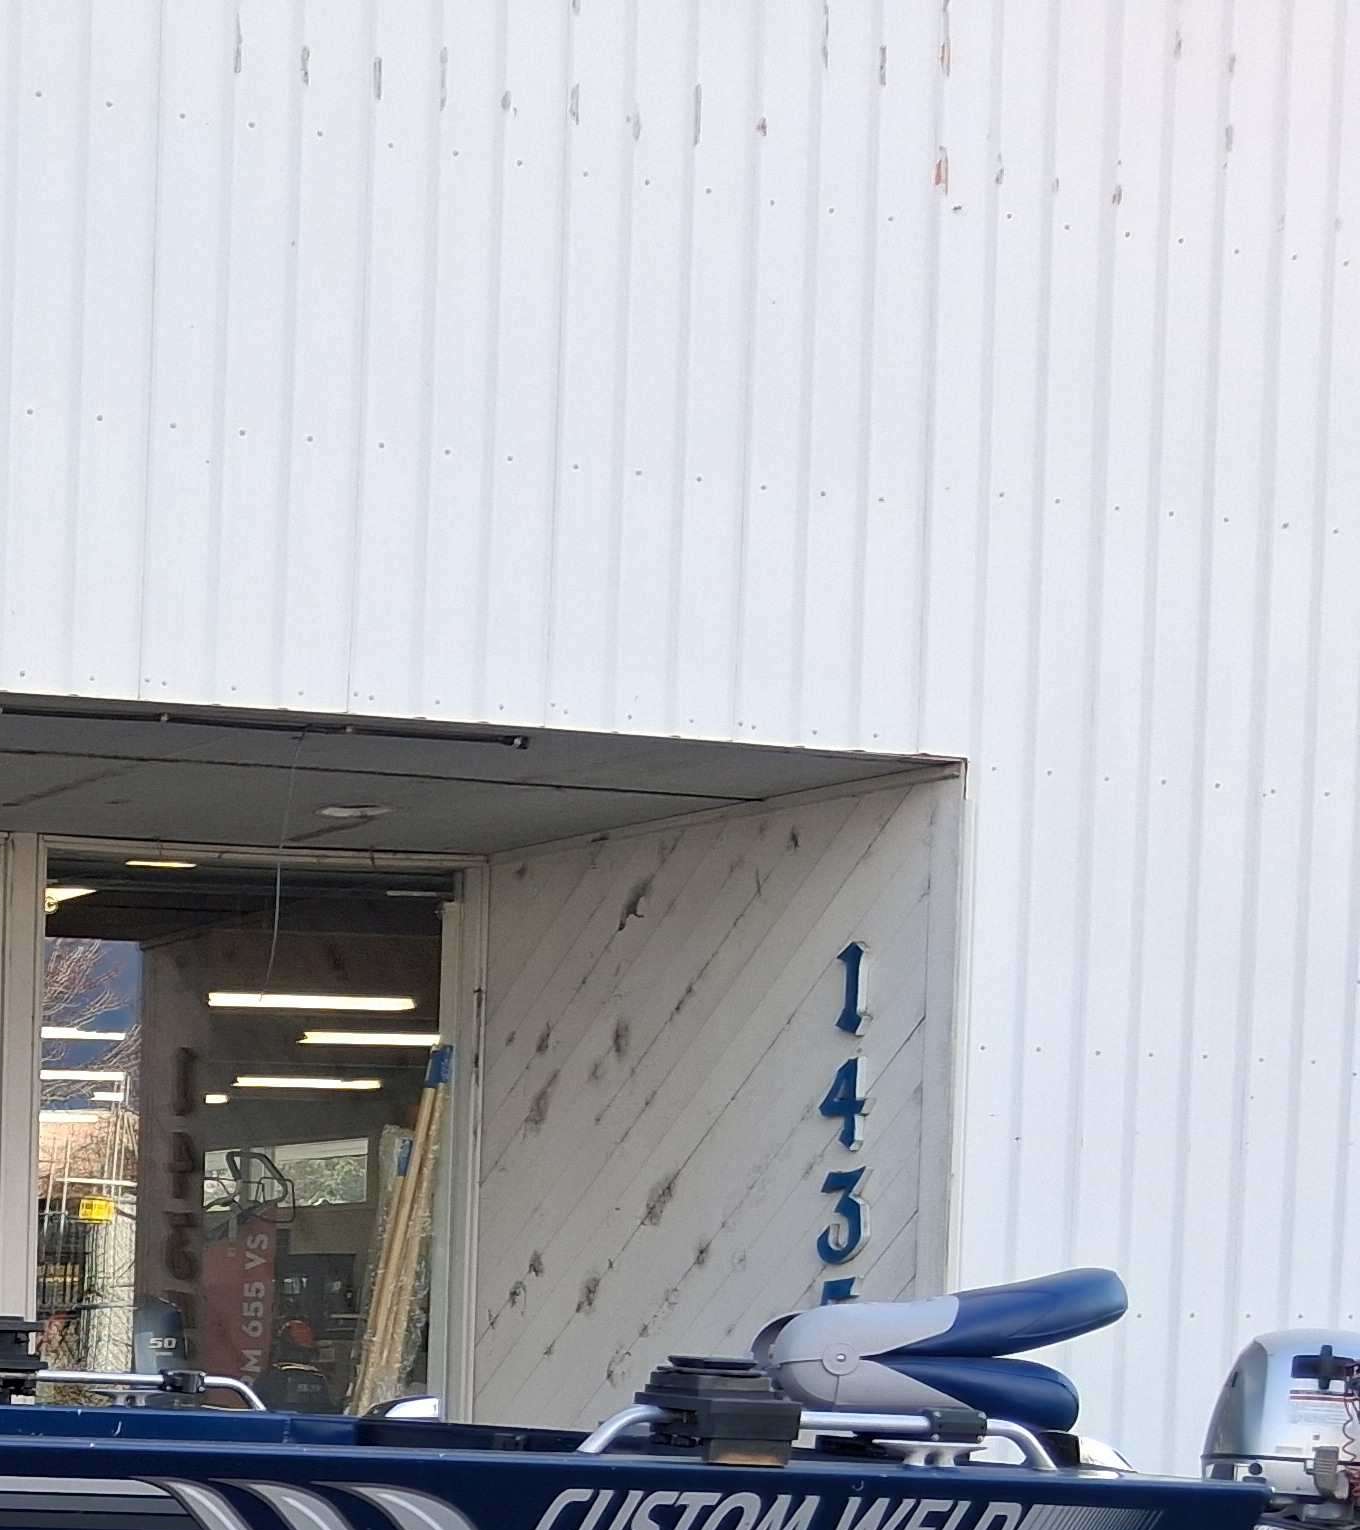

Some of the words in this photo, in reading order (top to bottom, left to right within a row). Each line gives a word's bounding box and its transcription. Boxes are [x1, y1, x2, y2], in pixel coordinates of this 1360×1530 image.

[817, 941, 872, 1305] 143
[244, 1233, 269, 1271] VS
[241, 1281, 265, 1338] 655
[148, 1337, 177, 1349] 50
